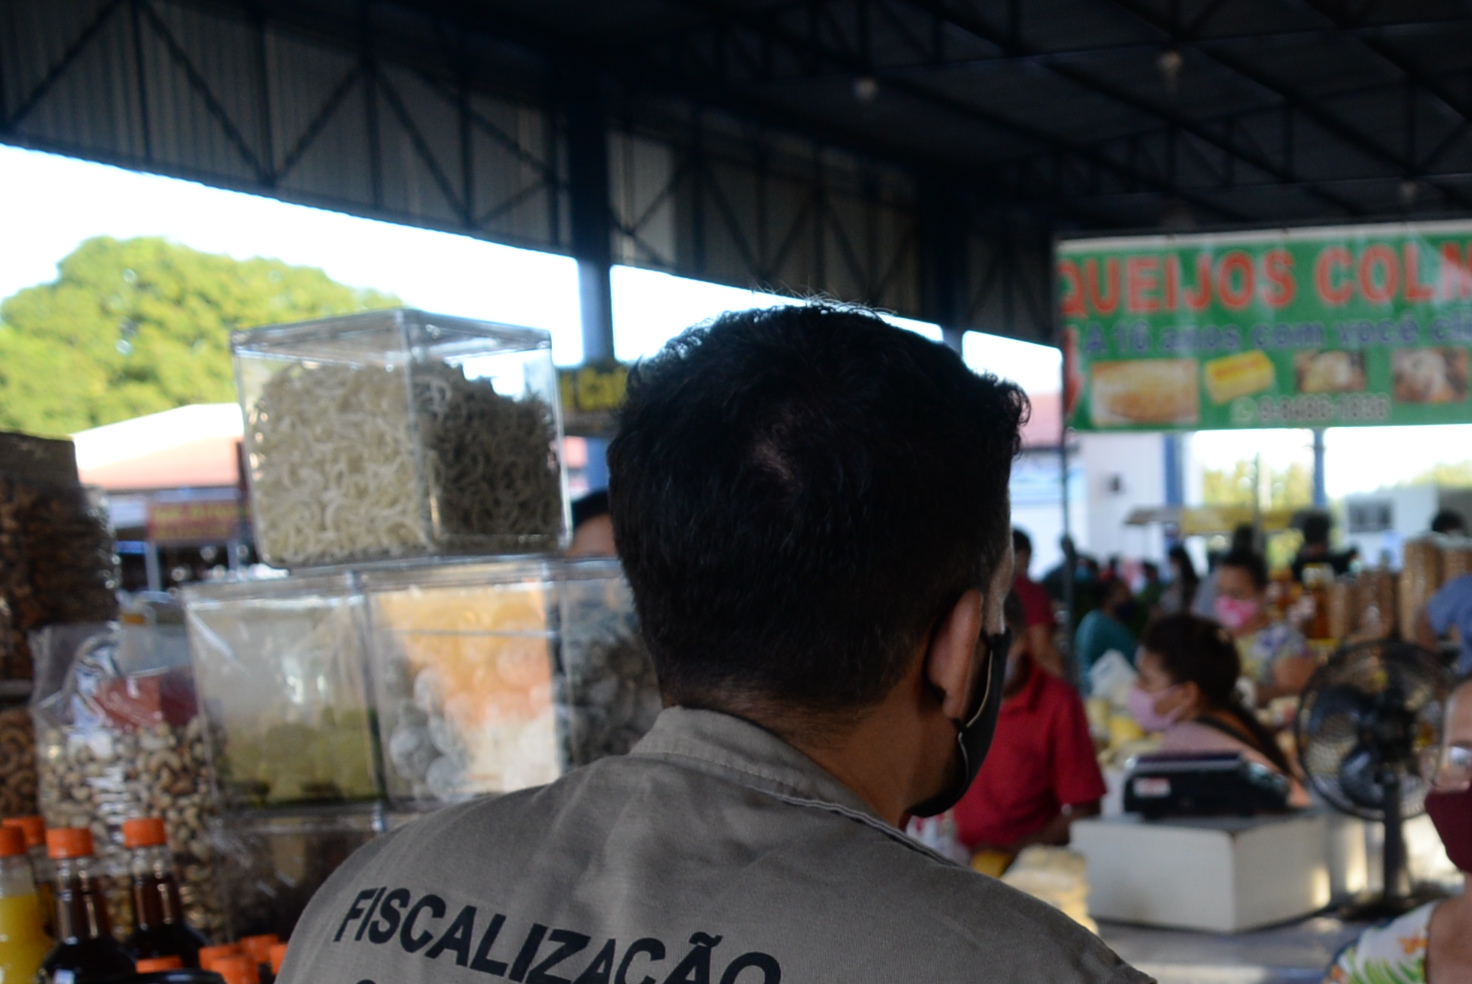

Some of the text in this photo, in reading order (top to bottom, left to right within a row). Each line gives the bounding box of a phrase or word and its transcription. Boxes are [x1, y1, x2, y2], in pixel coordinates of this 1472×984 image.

[1059, 247, 1296, 318] QUEIJOS
[1160, 323, 1243, 351] anos
[1250, 321, 1325, 348] com
[1335, 309, 1420, 345] você
